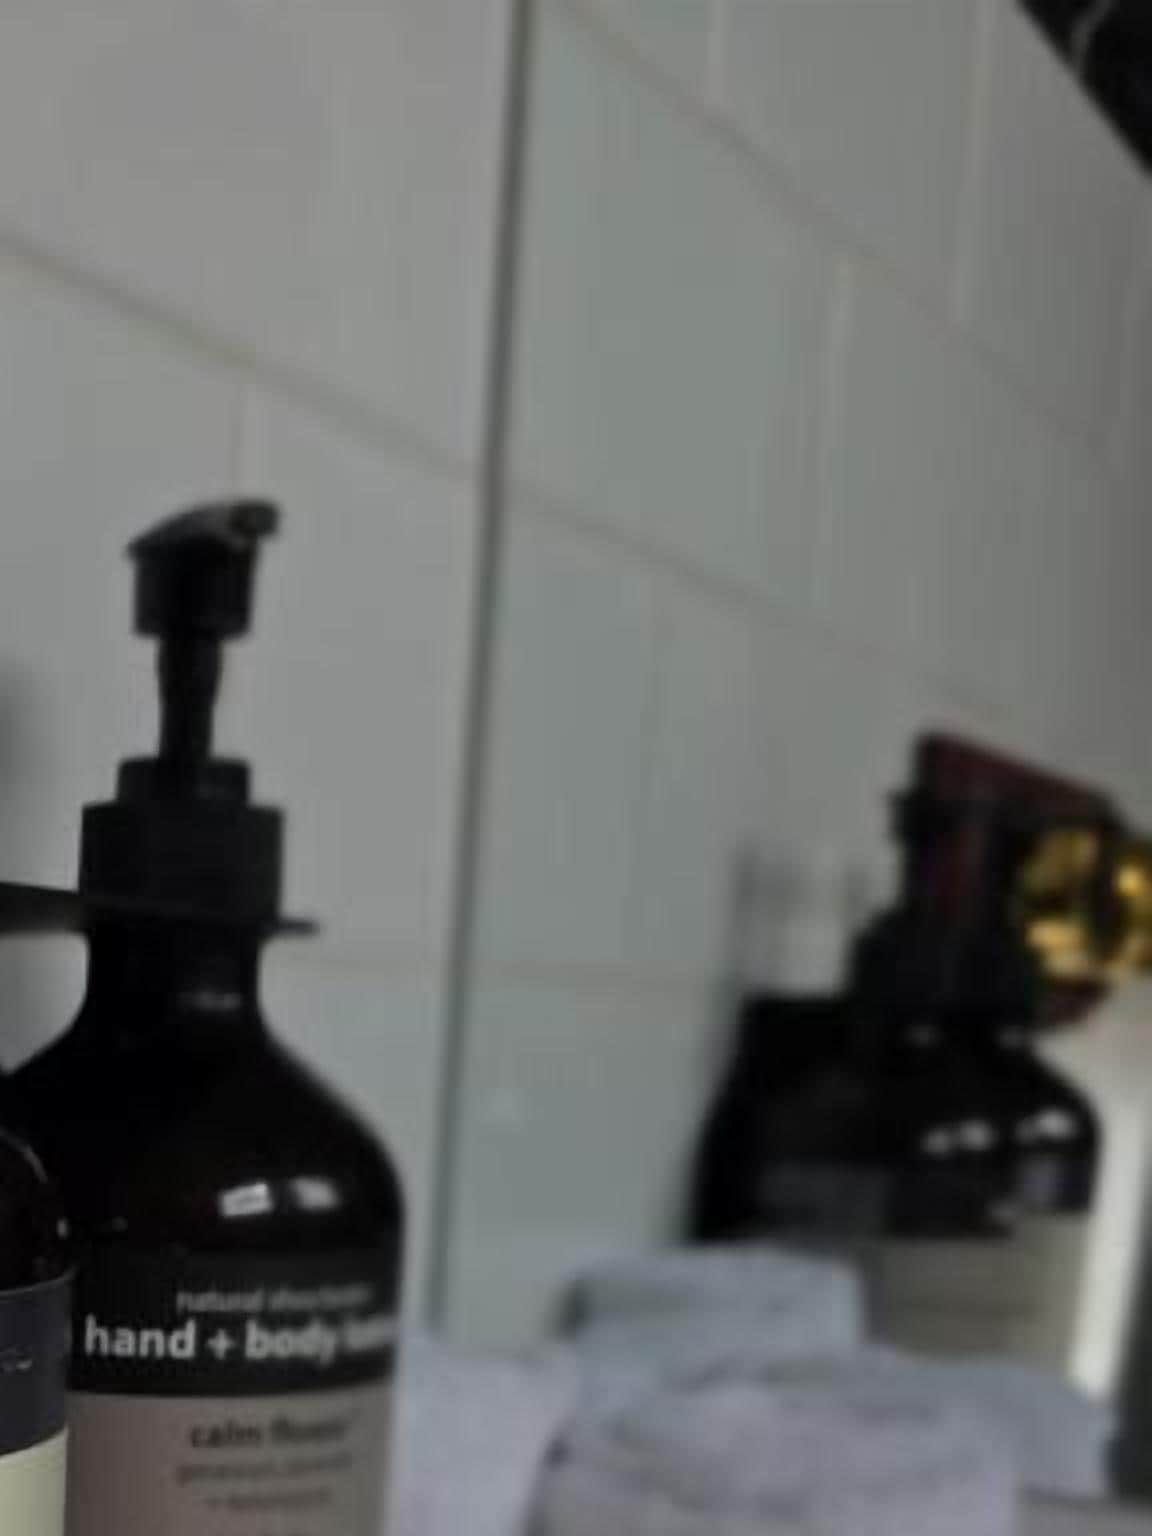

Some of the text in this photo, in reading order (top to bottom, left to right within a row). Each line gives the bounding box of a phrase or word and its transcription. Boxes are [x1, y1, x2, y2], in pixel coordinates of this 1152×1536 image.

[85, 1313, 197, 1360] hand
[205, 1328, 235, 1360] +
[245, 1320, 337, 1366] body
